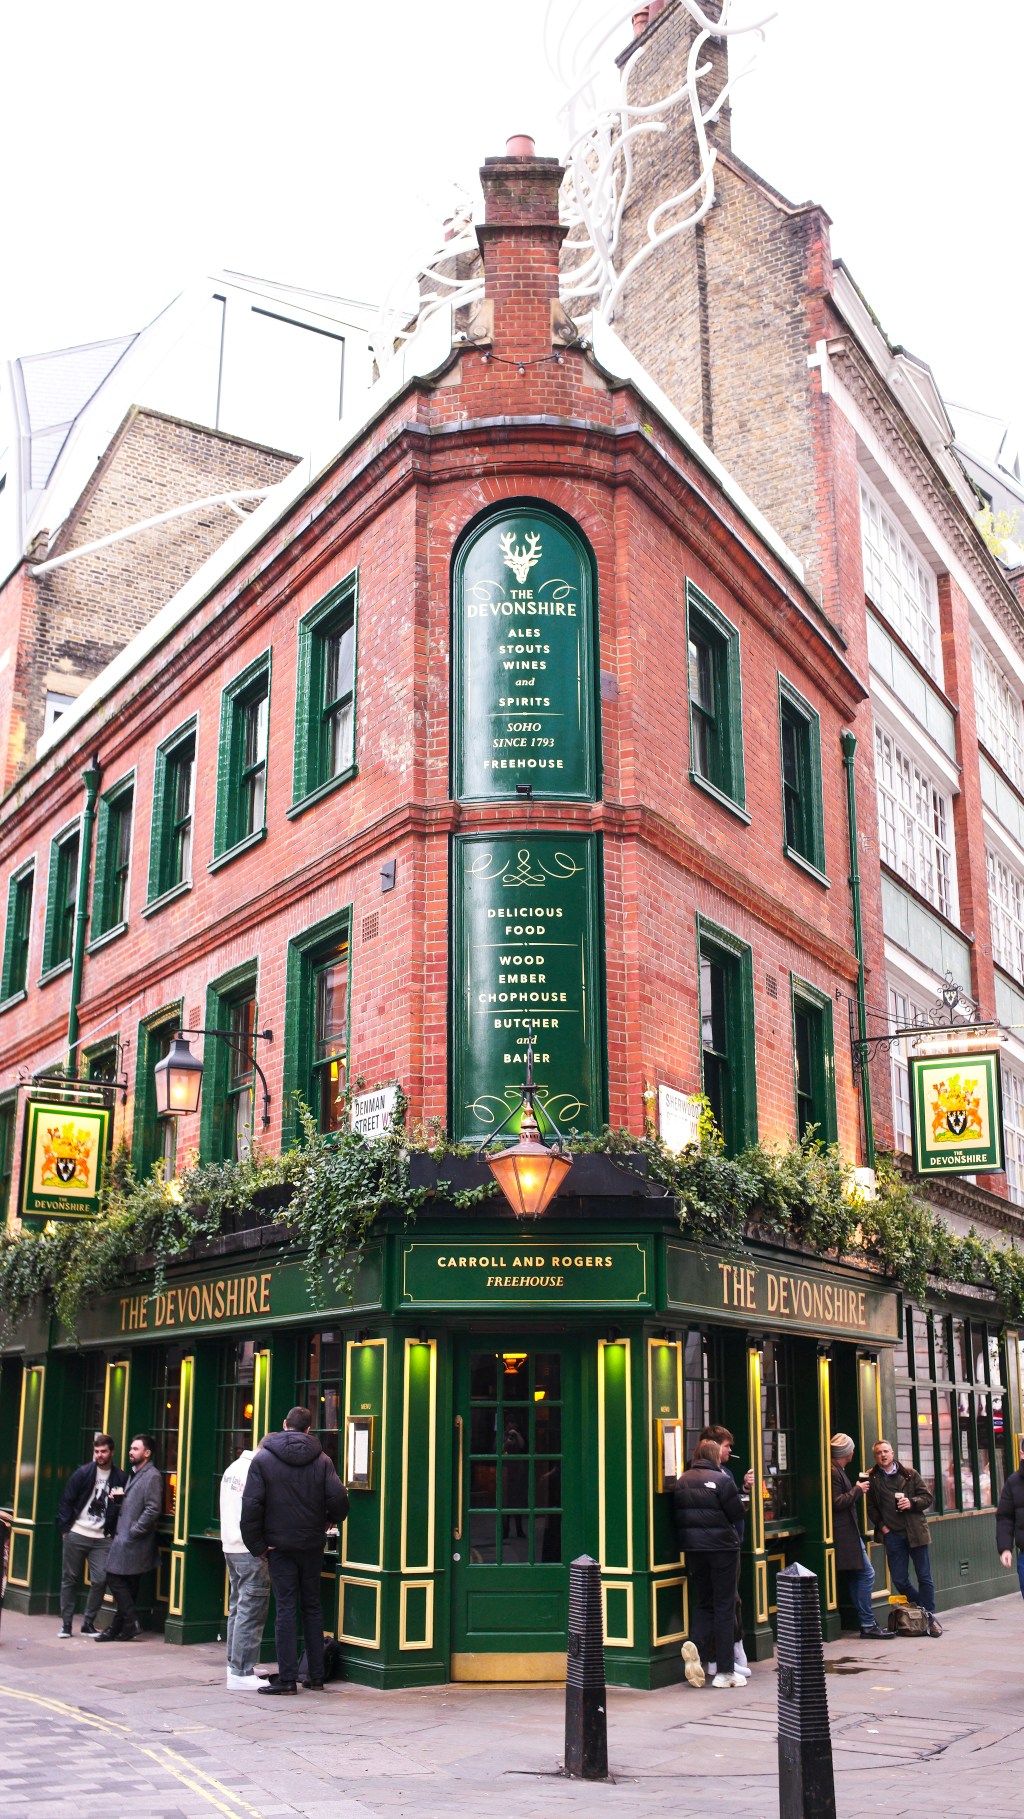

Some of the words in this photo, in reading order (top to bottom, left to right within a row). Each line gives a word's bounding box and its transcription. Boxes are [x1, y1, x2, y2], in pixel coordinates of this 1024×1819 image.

[510, 589, 533, 599] THE
[467, 601, 577, 618] DEVONSHIRE
[508, 628, 541, 638] ALES
[499, 645, 550, 654] STOUTS
[503, 661, 547, 670] WINES
[515, 677, 535, 687] and
[499, 697, 550, 707] SPIRITS
[507, 722, 542, 732] SOHO
[493, 738, 527, 748] SINCE
[530, 737, 555, 748] 1793
[483, 759, 564, 769] FREEHOUSE
[487, 908, 563, 918] DELICIOUS
[505, 925, 546, 935] FOOD
[499, 956, 545, 966] WOOD
[499, 974, 546, 984] EMBER
[479, 992, 567, 1003] CHOPHOUSE
[494, 1018, 559, 1028] BUTCHER
[516, 1034, 538, 1045] and
[355, 1094, 386, 1117] DENMAN
[354, 1114, 380, 1135] STREET
[930, 1153, 988, 1166] DEVONSHIRE
[34, 1199, 91, 1212] DEVONSHIRE
[437, 1256, 507, 1268] CARROLL
[512, 1256, 545, 1267] AND
[551, 1256, 613, 1267] ROGERS
[486, 1276, 564, 1288] FREEHOUSE
[718, 1263, 757, 1309] THE
[767, 1273, 866, 1326] DEVONSHIRE
[120, 1293, 148, 1331] THE
[154, 1273, 272, 1328] DEVONSHIRE
